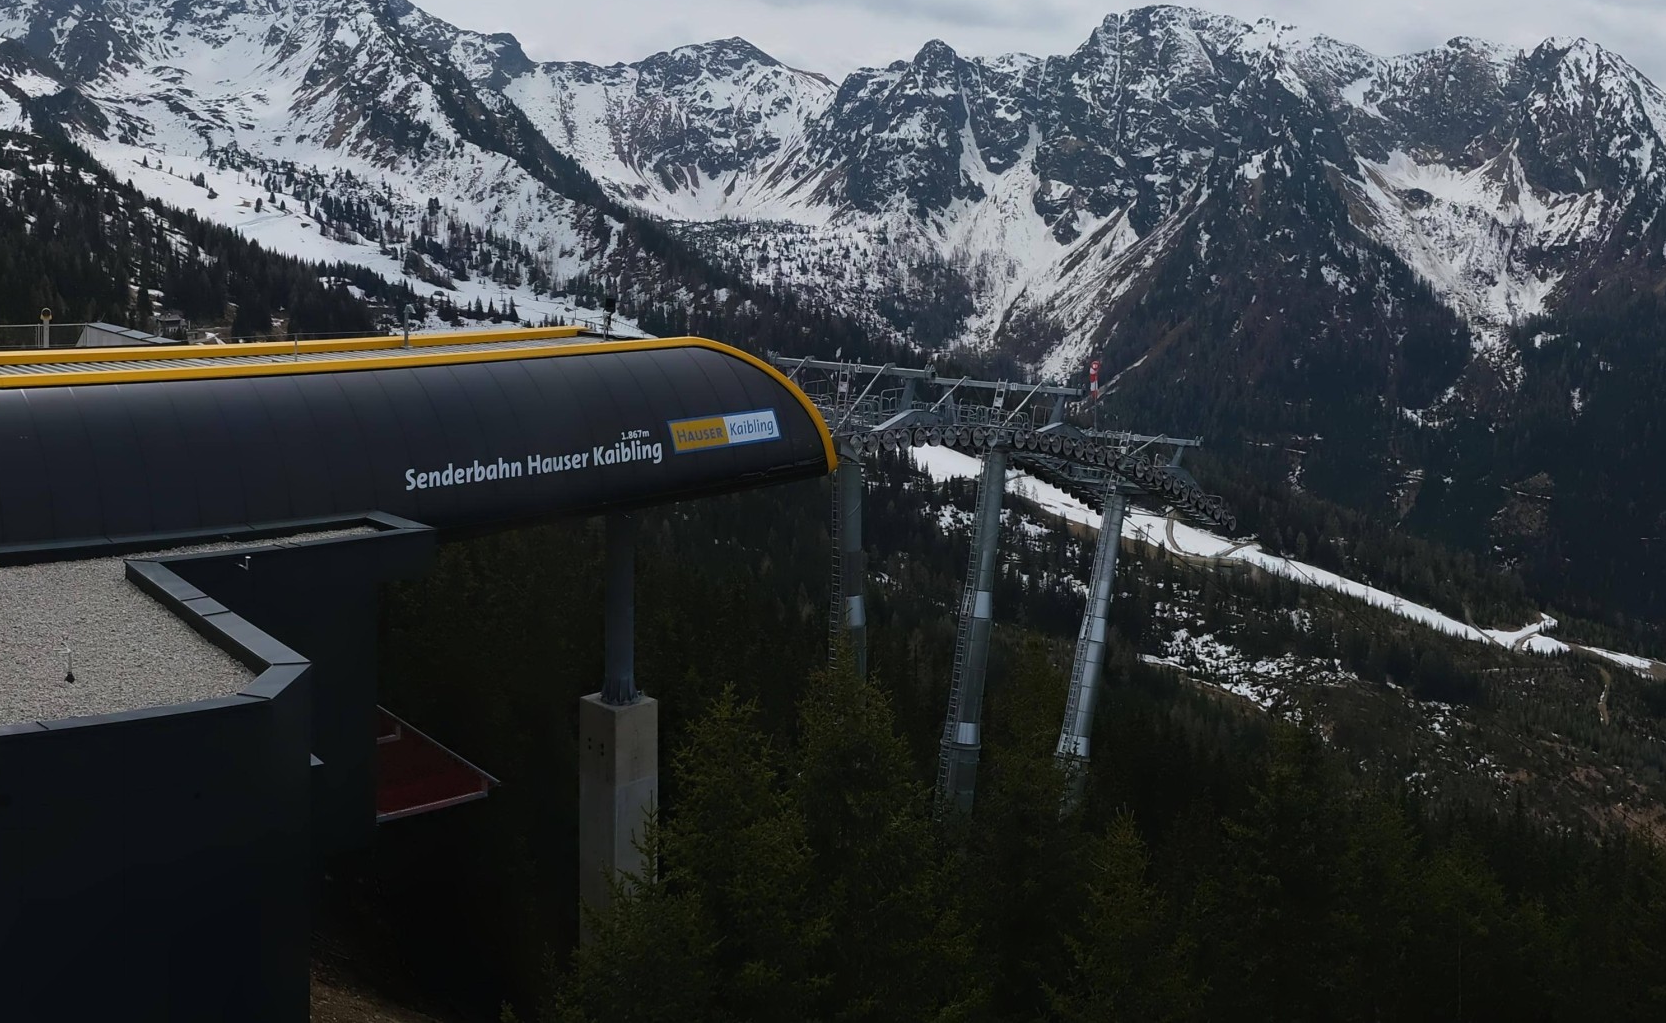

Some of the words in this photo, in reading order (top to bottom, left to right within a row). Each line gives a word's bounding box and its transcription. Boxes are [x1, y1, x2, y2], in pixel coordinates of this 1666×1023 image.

[621, 429, 650, 440] 1.867m
[676, 427, 723, 443] HAUSER
[729, 418, 774, 436] Kaibling
[405, 457, 522, 491] Senderbahn
[527, 452, 589, 475] Hauser
[593, 440, 663, 466] Kaibling
